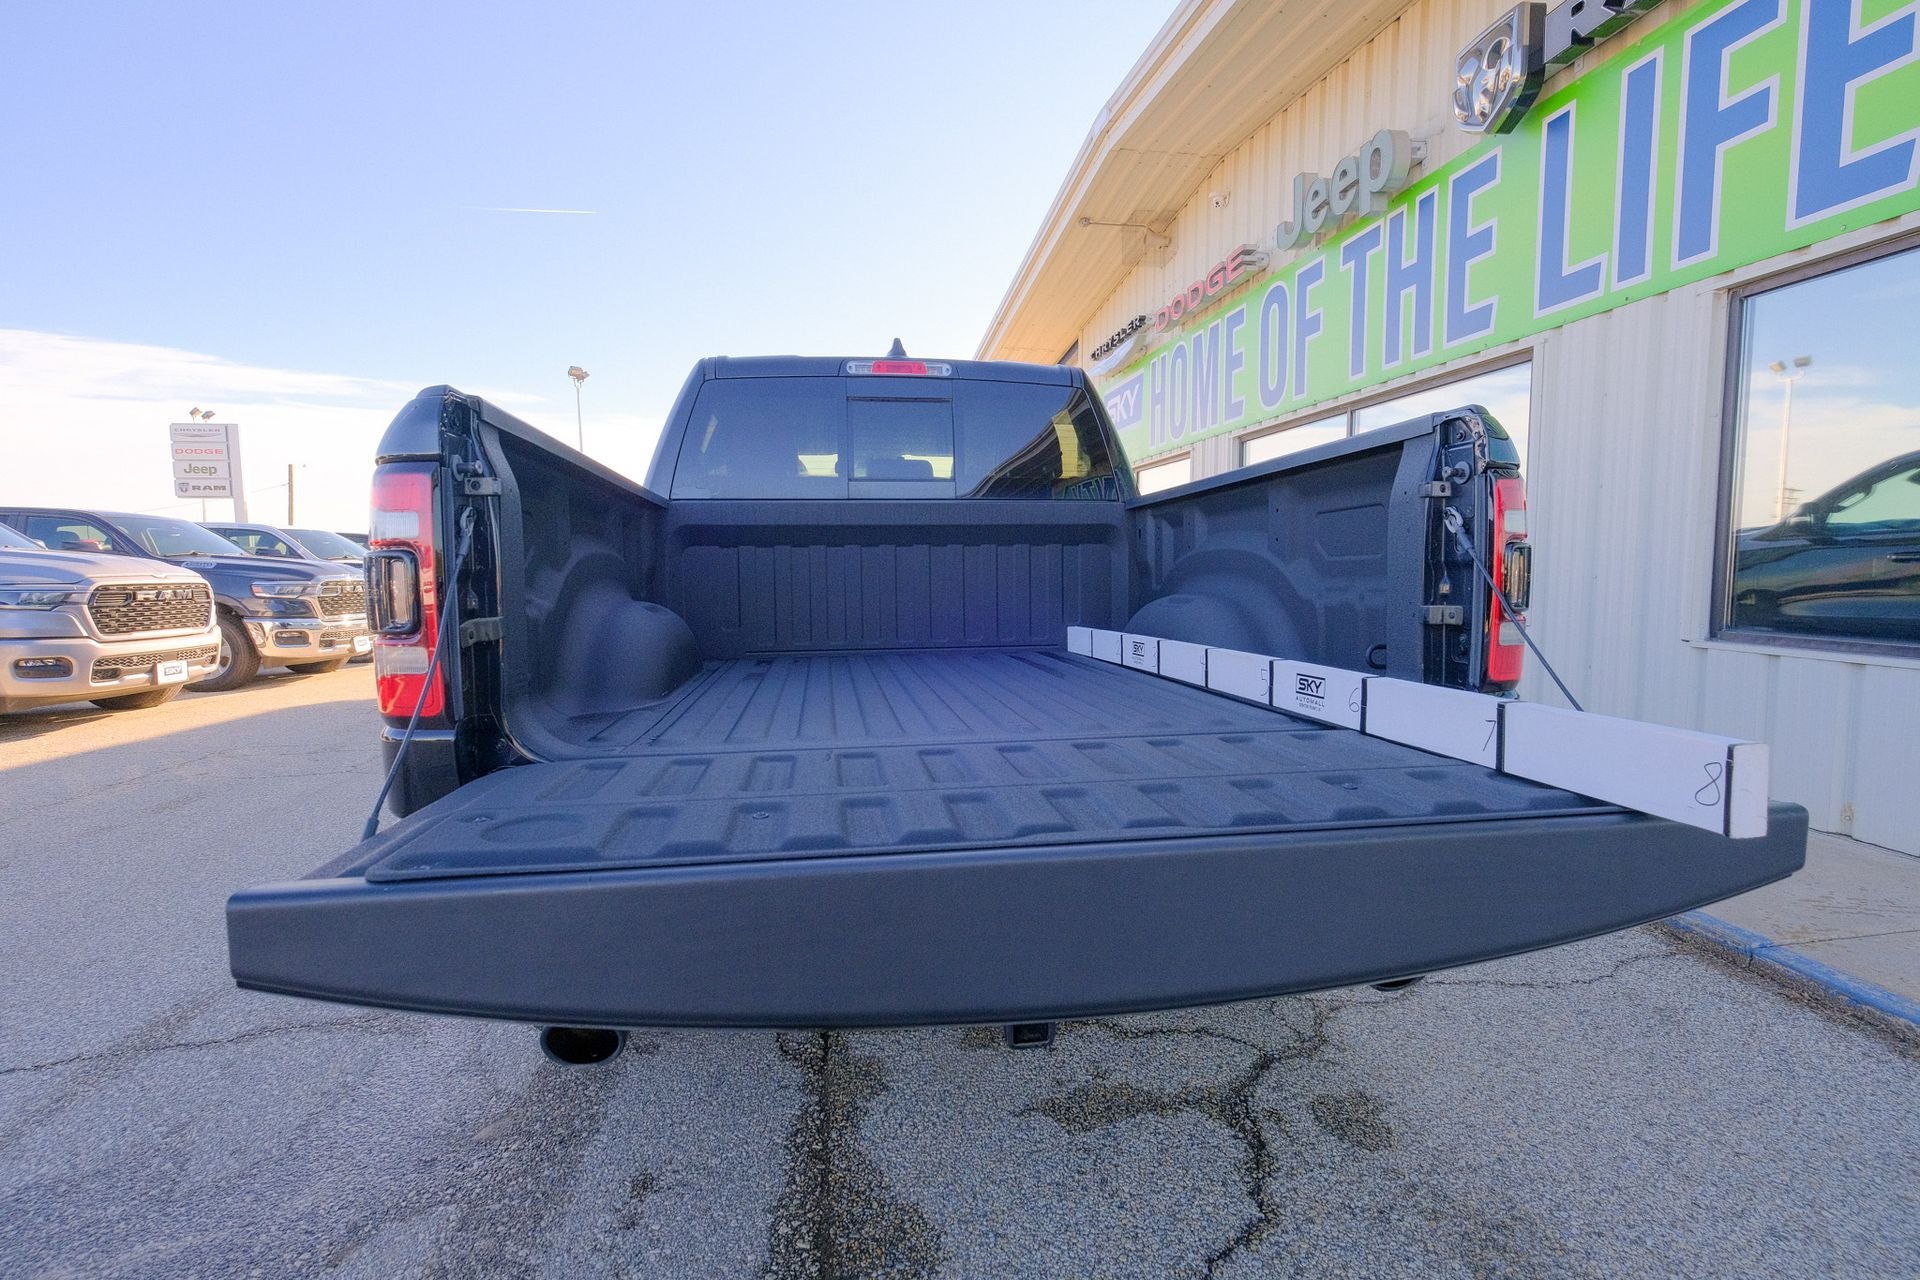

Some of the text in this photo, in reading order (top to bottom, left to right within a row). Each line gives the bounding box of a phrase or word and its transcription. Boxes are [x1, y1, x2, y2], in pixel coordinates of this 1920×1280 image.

[1277, 129, 1409, 251] Jeep
[1149, 0, 1920, 450] HOME OF THE LIFE
[1154, 245, 1256, 333] DODGE
[183, 463, 218, 476] Jeep
[1260, 668, 1269, 697] 5
[1298, 677, 1323, 694] SKY
[1348, 687, 1360, 713] 6
[1482, 719, 1497, 752] 7
[1694, 761, 1723, 807] 8
